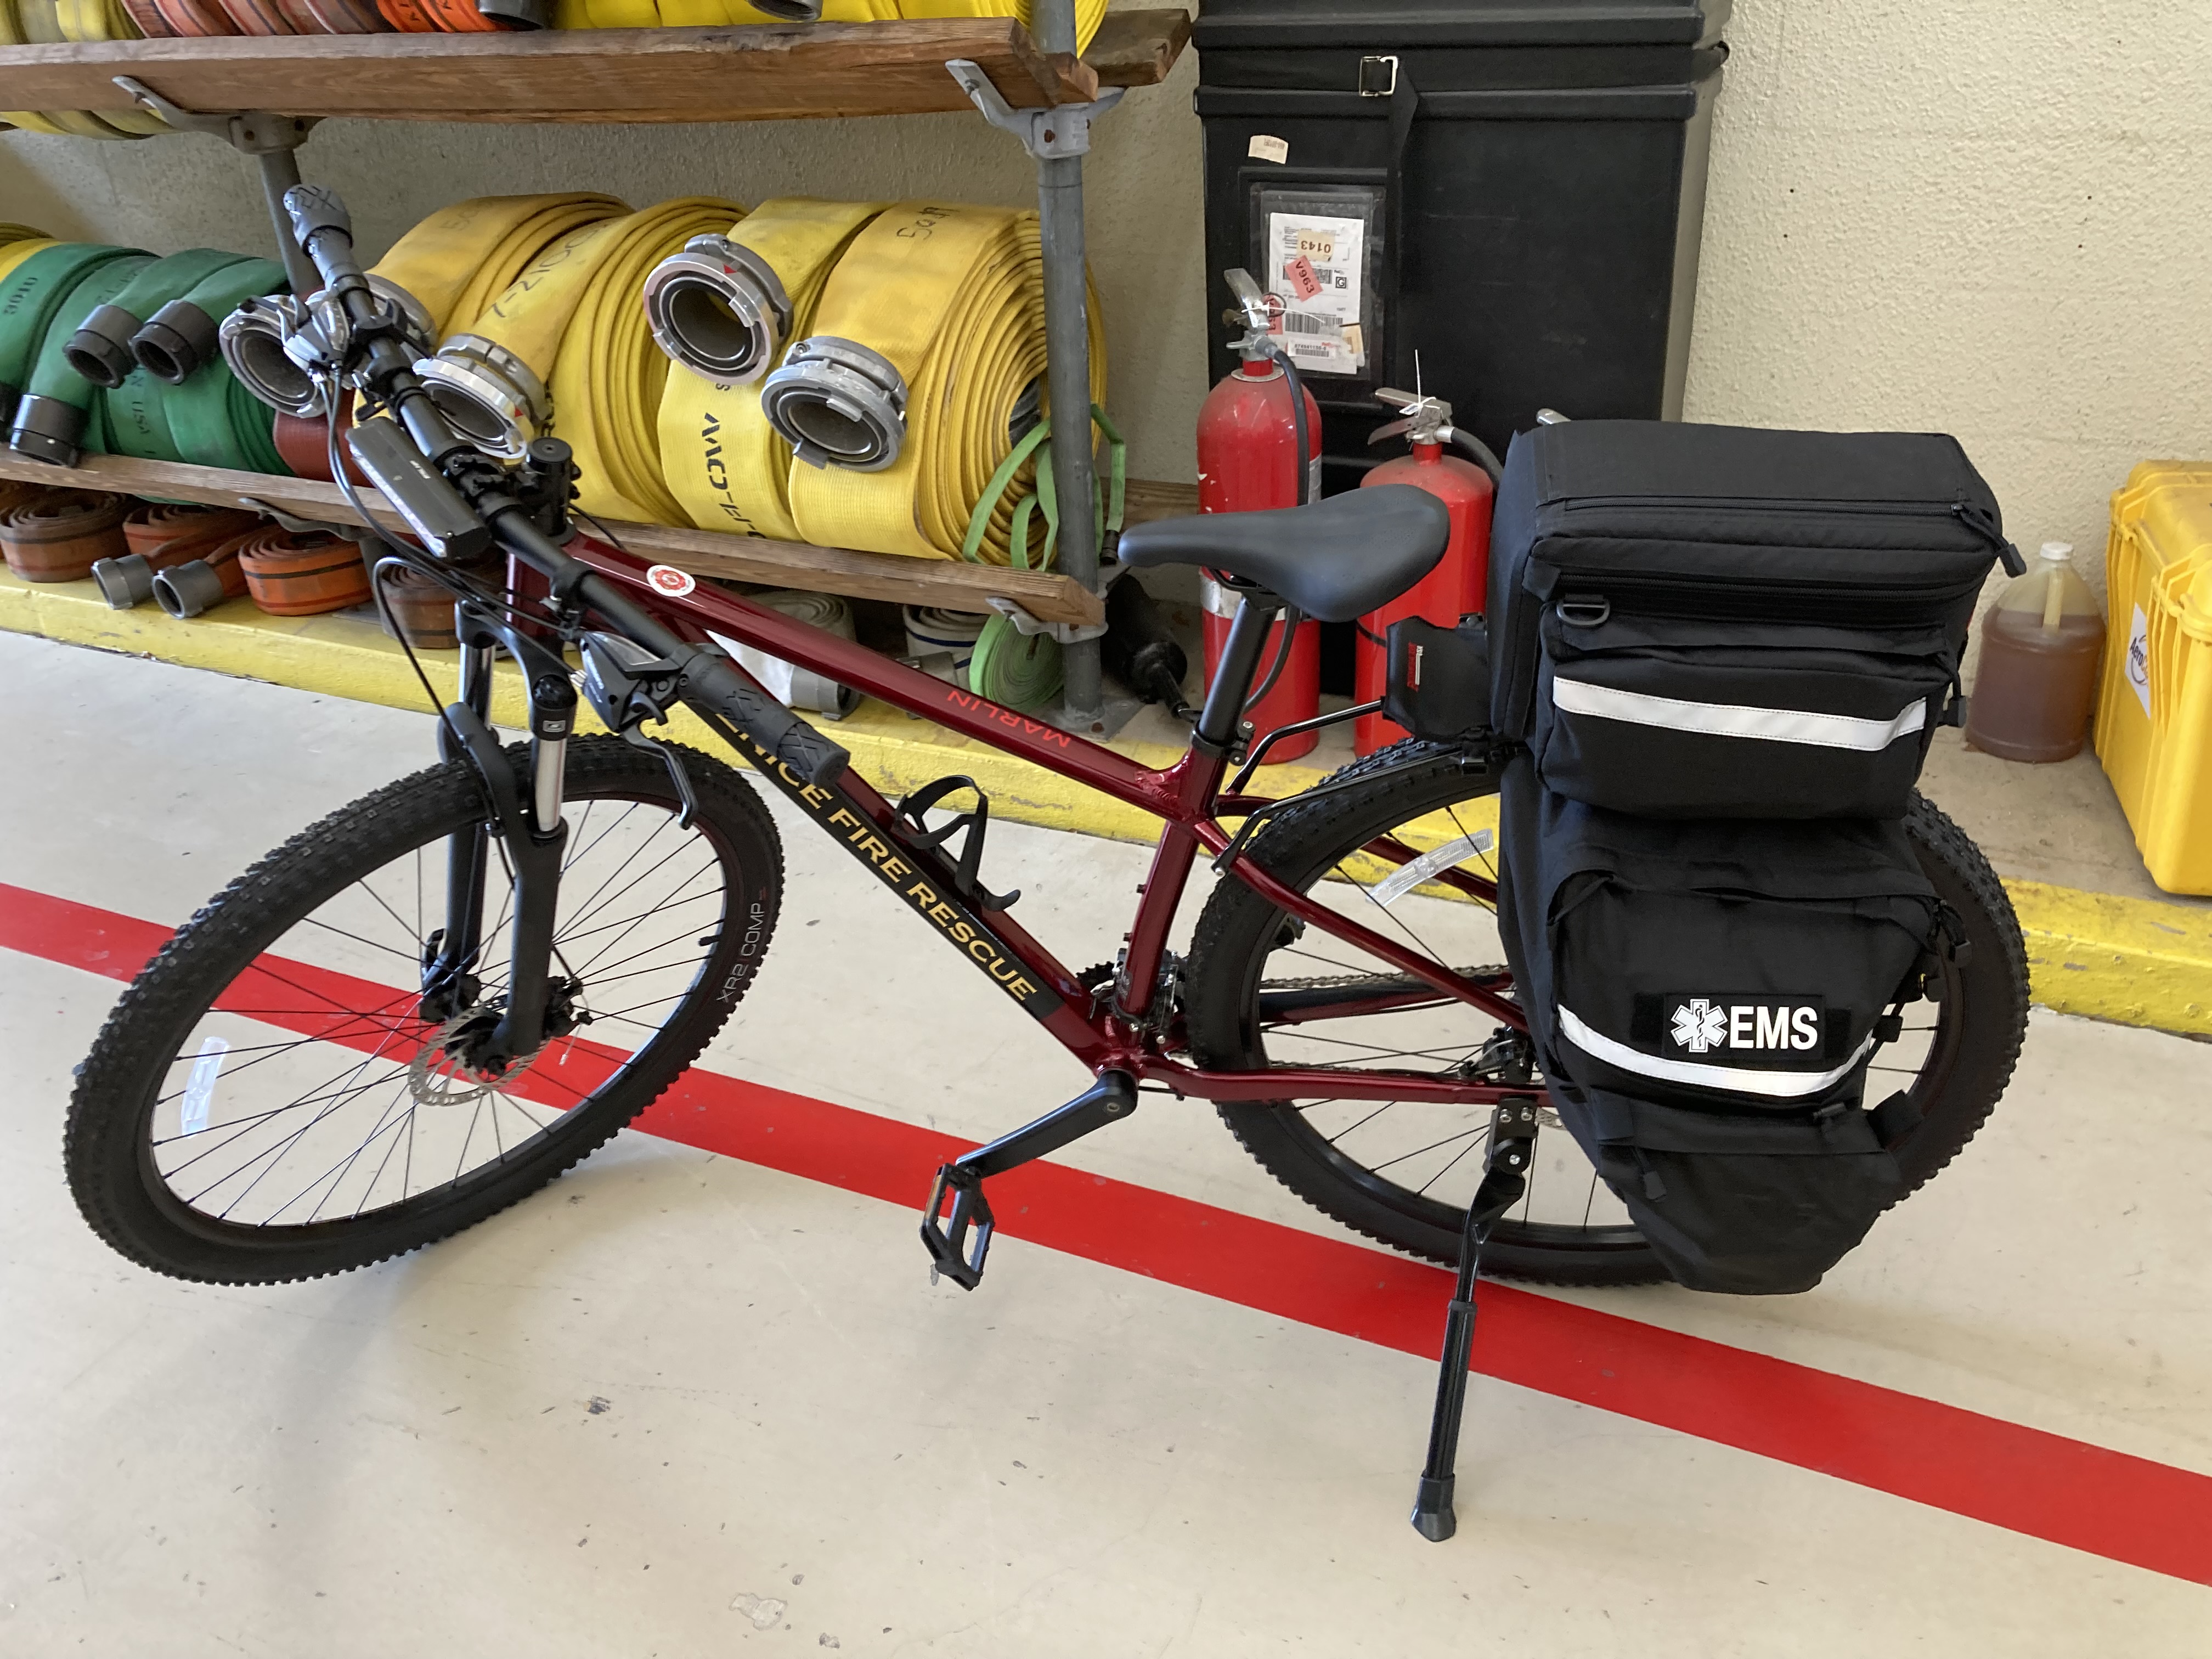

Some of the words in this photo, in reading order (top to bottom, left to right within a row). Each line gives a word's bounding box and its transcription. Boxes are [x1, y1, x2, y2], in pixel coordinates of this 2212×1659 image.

[1301, 240, 1331, 253] 0143
[1295, 261, 1315, 294] V963
[947, 690, 1071, 749] MARLIN
[828, 805, 913, 884] FIRE
[906, 881, 1038, 1002] RESCUE
[715, 963, 749, 1003] XR2
[740, 902, 765, 957] COMP
[1729, 1005, 1818, 1051] EMS
